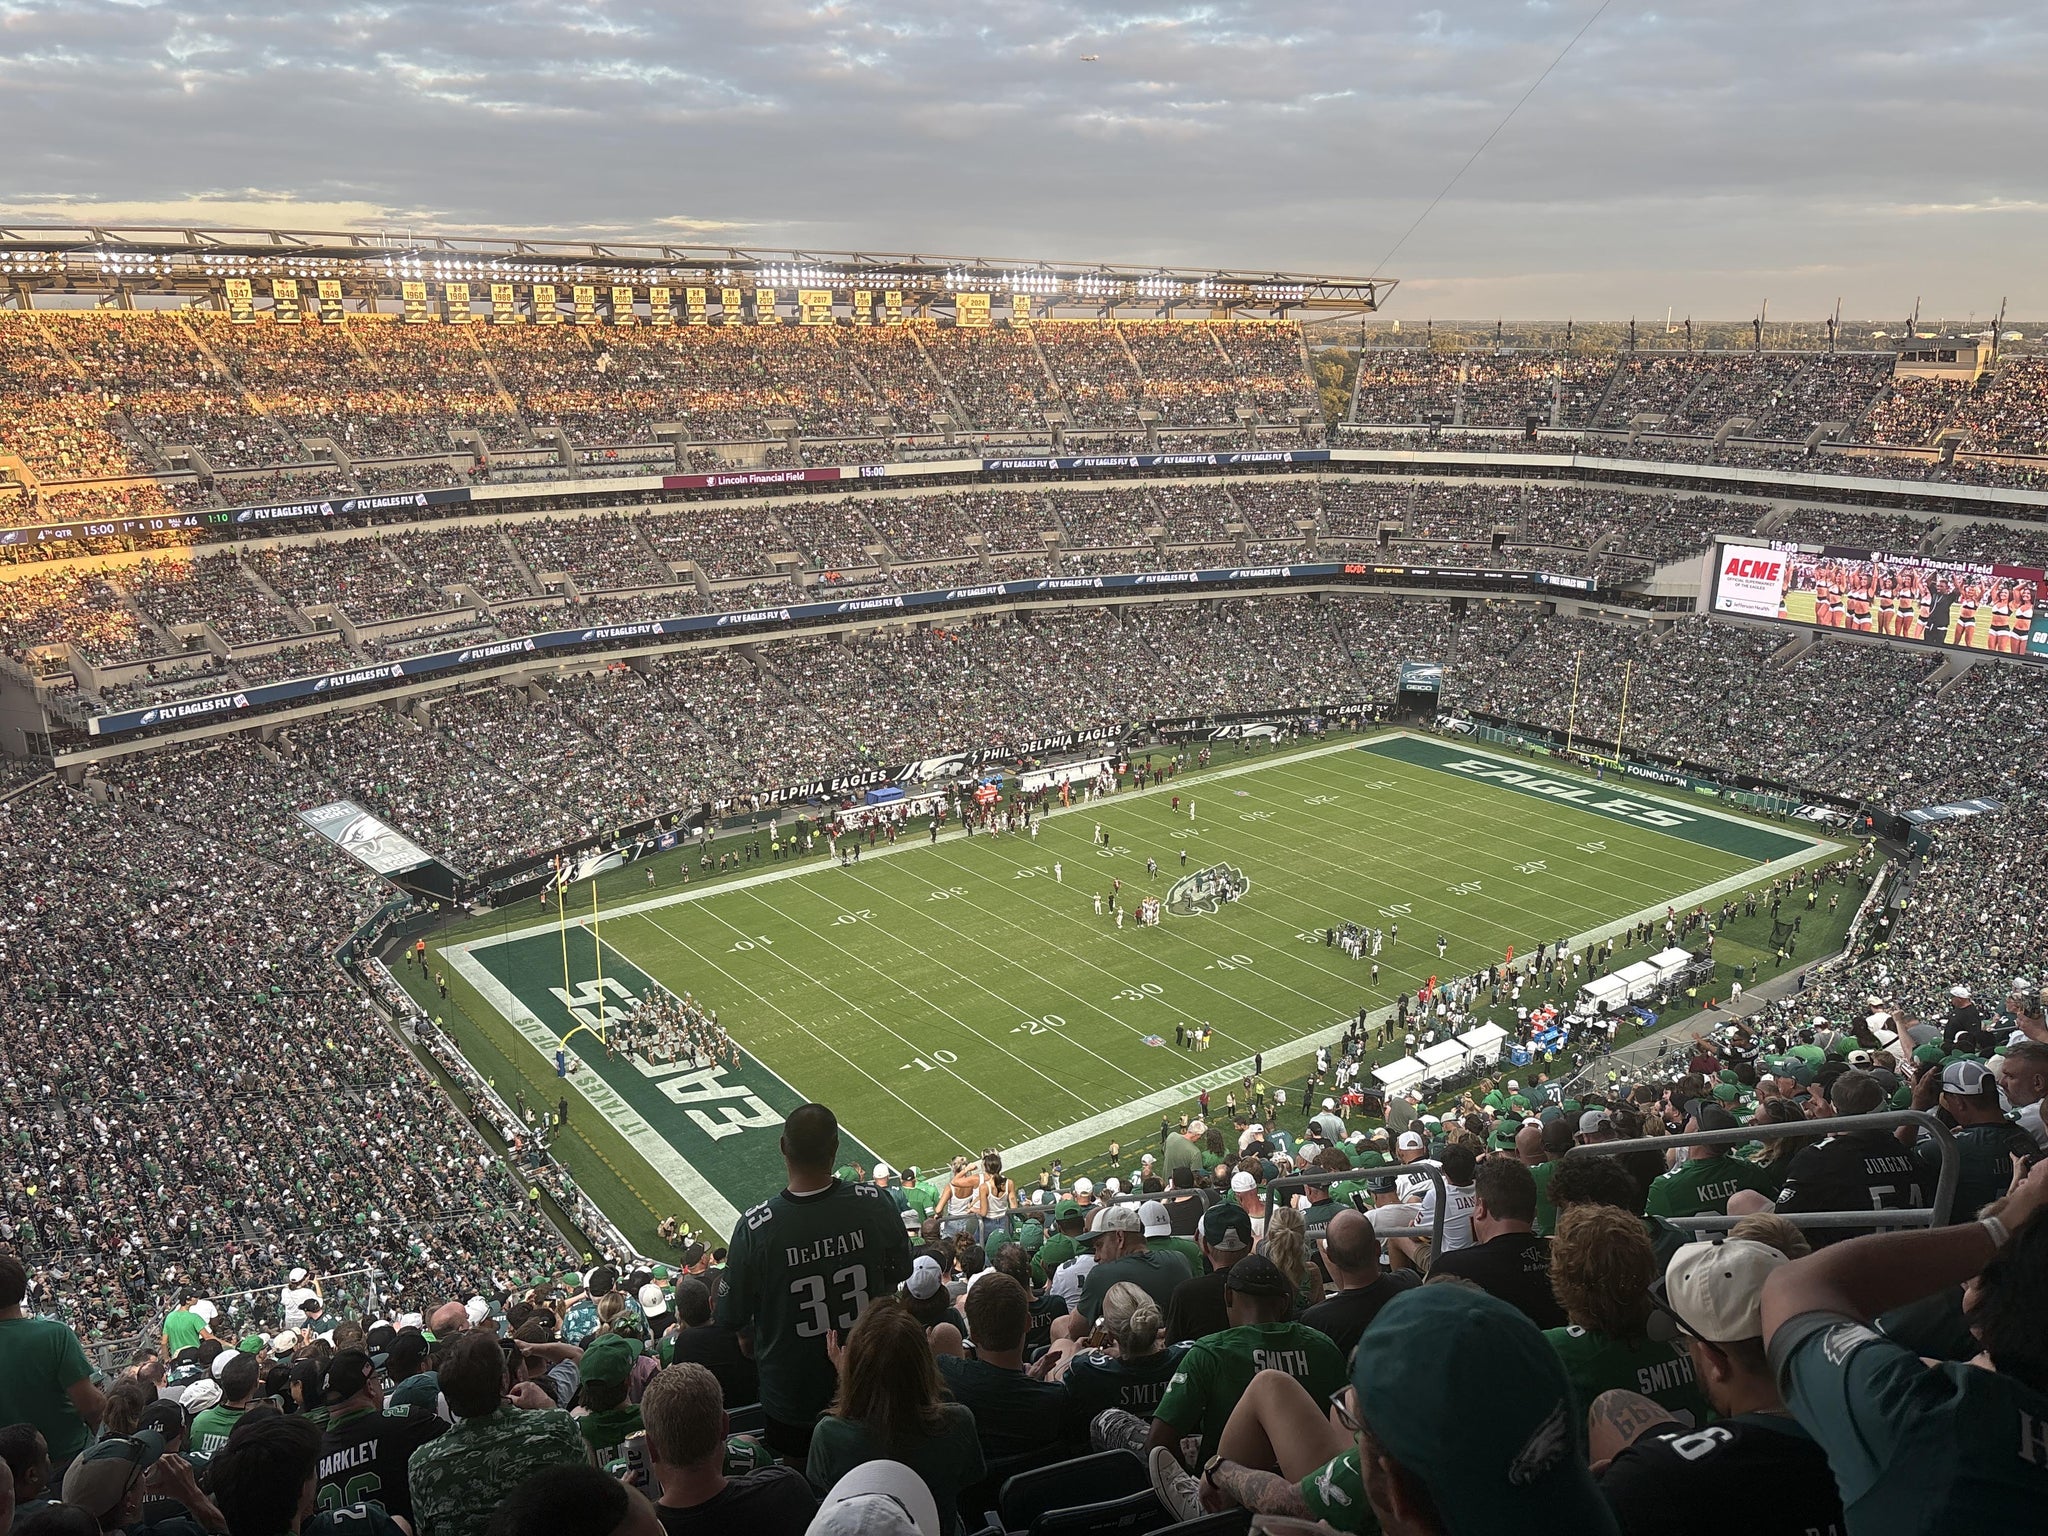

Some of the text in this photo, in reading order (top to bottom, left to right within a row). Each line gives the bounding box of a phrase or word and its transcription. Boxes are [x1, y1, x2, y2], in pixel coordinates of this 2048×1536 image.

[230, 289, 249, 298] 1947
[276, 289, 296, 298] 1948
[322, 290, 340, 298] 1949
[406, 291, 424, 300] 1960
[494, 293, 512, 302] 1988
[536, 294, 554, 302] 2001
[576, 294, 593, 303] 2002
[614, 295, 632, 303] 2003
[652, 296, 668, 304] 2004
[688, 296, 704, 304] 2006
[724, 296, 740, 304] 2010
[813, 296, 827, 304] 2017
[886, 298, 901, 306] 2022
[1084, 459, 1095, 467] FLY
[1095, 458, 1117, 466] EAGLES
[1164, 456, 1174, 464] FLY
[1241, 454, 1251, 462] FLY
[1272, 453, 1283, 461] FLY
[1002, 460, 1048, 469] FLY EAGLES FLY
[718, 470, 805, 486] Lincoln Financial Field
[860, 466, 884, 477] 15:00
[358, 495, 414, 510] FLY EAGLES FLY
[255, 504, 318, 520] FLY EAGLES FLY
[123, 522, 135, 532] 1ST
[151, 520, 163, 530] 10
[184, 516, 198, 526] 46
[208, 514, 229, 524] 1:10
[37, 524, 115, 540] 4TH QTR 15:00
[1770, 540, 1798, 552] 15:00
[1724, 558, 1781, 581] ACME
[1884, 552, 1994, 576] Lincoln Financial Field
[1146, 573, 1188, 583] FLY EAGLES FLY
[1240, 568, 1281, 578] FLY EAGLES FLY
[1049, 578, 1093, 588] FLY EAGLES FLY
[957, 586, 998, 598] FLY EAGLES FLY
[849, 598, 894, 610] FLY EAGLES FLY
[1755, 604, 1770, 612] Health
[730, 610, 779, 623] FLY EAGLES FLY
[596, 624, 650, 639] FLY EAGLES FLY
[472, 641, 523, 659] FLY EAGLES FLY
[330, 666, 390, 687] FLY EAGLES FLY
[159, 698, 231, 720] FLY EAGLES FLY
[1339, 703, 1373, 714] EAGLES
[982, 725, 1122, 762] PHILDELPHIA EAGLES
[831, 770, 887, 790] EAGLES
[1628, 765, 1688, 788] FOUNDATION
[1364, 780, 1393, 790] 10
[1441, 758, 1698, 827] EAGLES
[1303, 795, 1335, 806] 20
[312, 804, 340, 816] BUD
[312, 808, 351, 823] LIGHT
[1238, 810, 1271, 823] 30
[1169, 827, 1200, 839] 40
[1096, 846, 1131, 859] 50
[1576, 842, 1607, 854] 10
[380, 852, 408, 862] BUD
[382, 856, 422, 869] LIGHT
[1017, 865, 1048, 879] 40
[1512, 862, 1547, 875] 20
[930, 886, 969, 901] 30
[1446, 882, 1482, 896] 30
[838, 908, 878, 925] 20
[1378, 904, 1411, 919] 40
[735, 934, 775, 952] 10
[1217, 954, 1254, 973] 40
[1120, 982, 1163, 1001] 30
[1020, 1014, 1066, 1035] 20
[914, 1049, 958, 1072] 10
[515, 1018, 649, 1136] IT TAKES OF US
[1176, 1060, 1256, 1098] KICKOFF
[1547, 1088, 1561, 1103] 27
[1279, 1138, 1287, 1152] 1
[1864, 1156, 1913, 1176] JURGENS
[1696, 1178, 1740, 1203] KELCE
[790, 1264, 869, 1338] 33
[1252, 1350, 1308, 1376] SMITH
[1637, 1358, 1693, 1394] SMITH
[1120, 1380, 1170, 1405] SMIT
[318, 1439, 378, 1480] BARKLEY
[334, 1504, 366, 1524] 2
